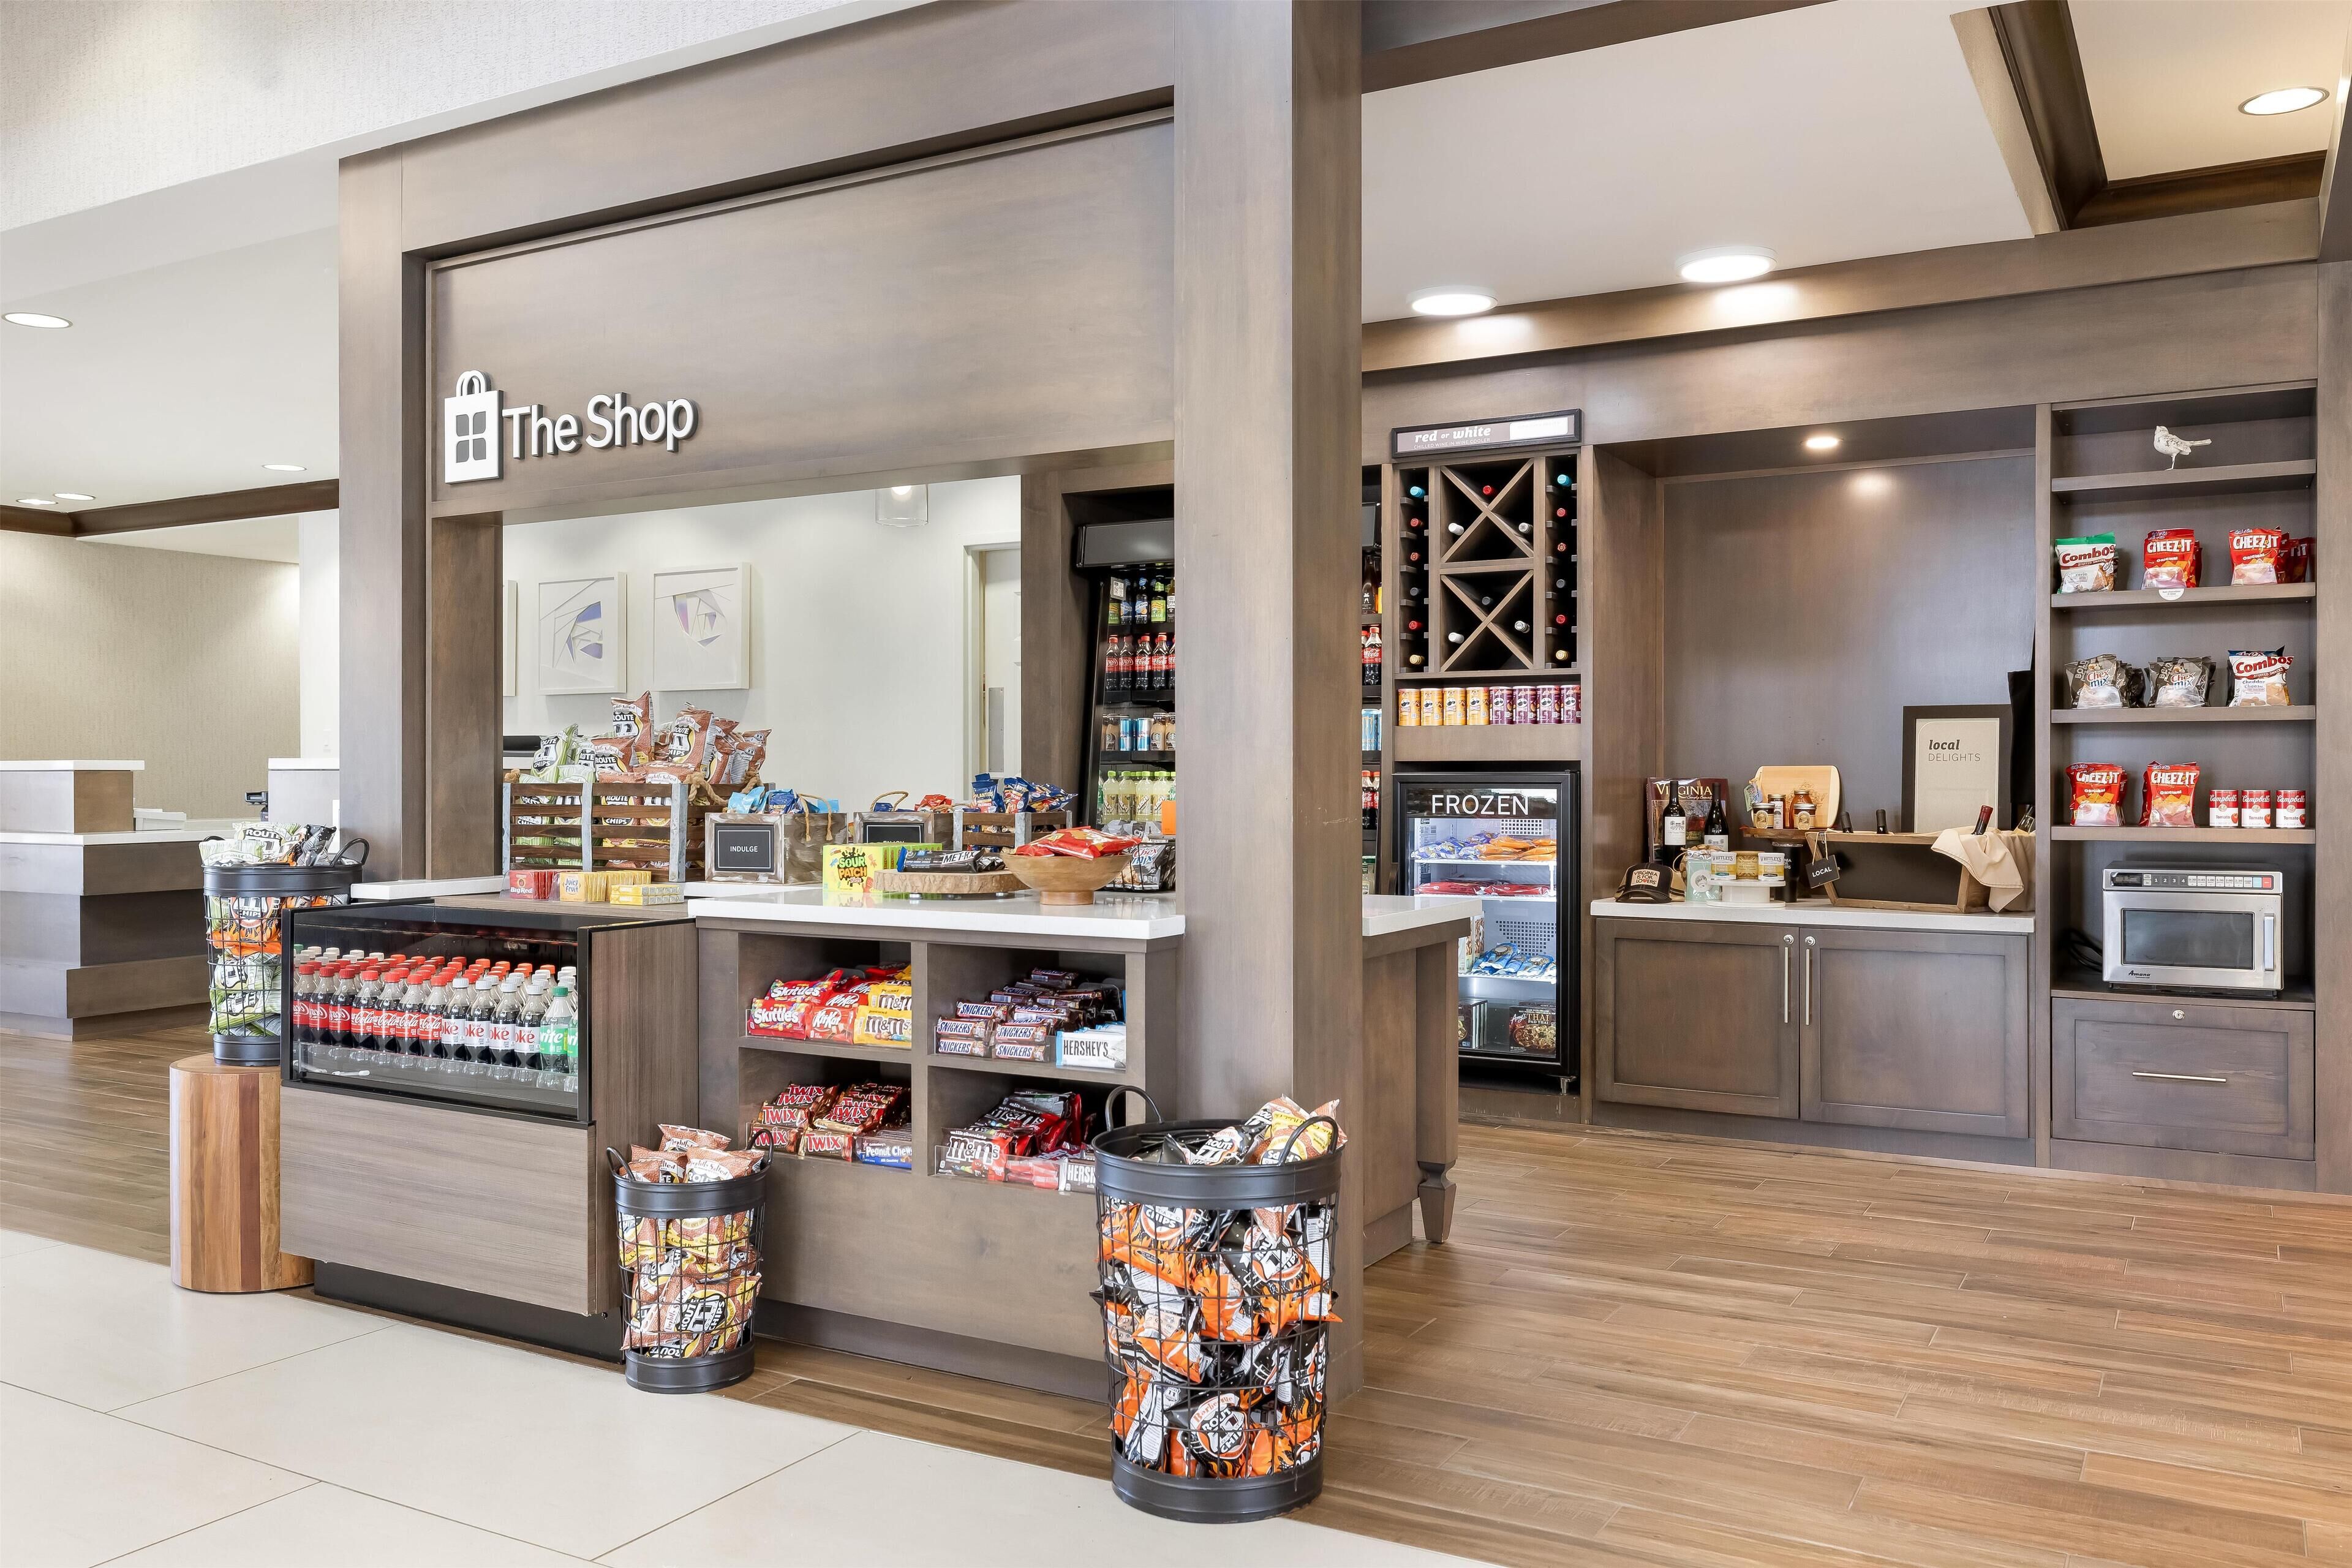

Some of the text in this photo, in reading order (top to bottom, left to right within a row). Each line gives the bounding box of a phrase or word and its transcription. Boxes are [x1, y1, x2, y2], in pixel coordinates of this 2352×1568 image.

[502, 392, 698, 459] The Shop
[1415, 430, 1438, 443] red
[1453, 426, 1491, 439] white
[2062, 545, 2115, 564] Combos
[2236, 657, 2294, 674] Combos
[2087, 669, 2110, 681] Chex
[2171, 672, 2196, 682] Chex
[1929, 739, 1960, 750] local
[1928, 753, 1981, 761] DELIGHTS
[1656, 783, 1713, 796] VIGINIA
[1431, 794, 1529, 815] FROZEN
[1133, 848, 1158, 858] Chex
[839, 857, 865, 869] SOUR
[839, 867, 867, 879] PATCH
[1812, 866, 1832, 878] LOCAL
[565, 876, 579, 886] Juicy
[565, 884, 579, 893] Fruit
[771, 986, 821, 998] Skittles
[754, 1008, 799, 1024] Skittles
[960, 1003, 995, 1016] SNICKERS
[1510, 1012, 1527, 1025] Amy's
[938, 1022, 973, 1034] SNICKERS
[997, 1026, 1033, 1039] SNICKERS
[939, 1041, 971, 1054] SNICKERS
[996, 1044, 1033, 1058] SNICKERS
[1063, 1039, 1109, 1057] HERSHEY'S
[866, 1146, 891, 1157] Peanut
[1068, 1163, 1095, 1182] HERSH
[1146, 1209, 1177, 1228] CHIPS
